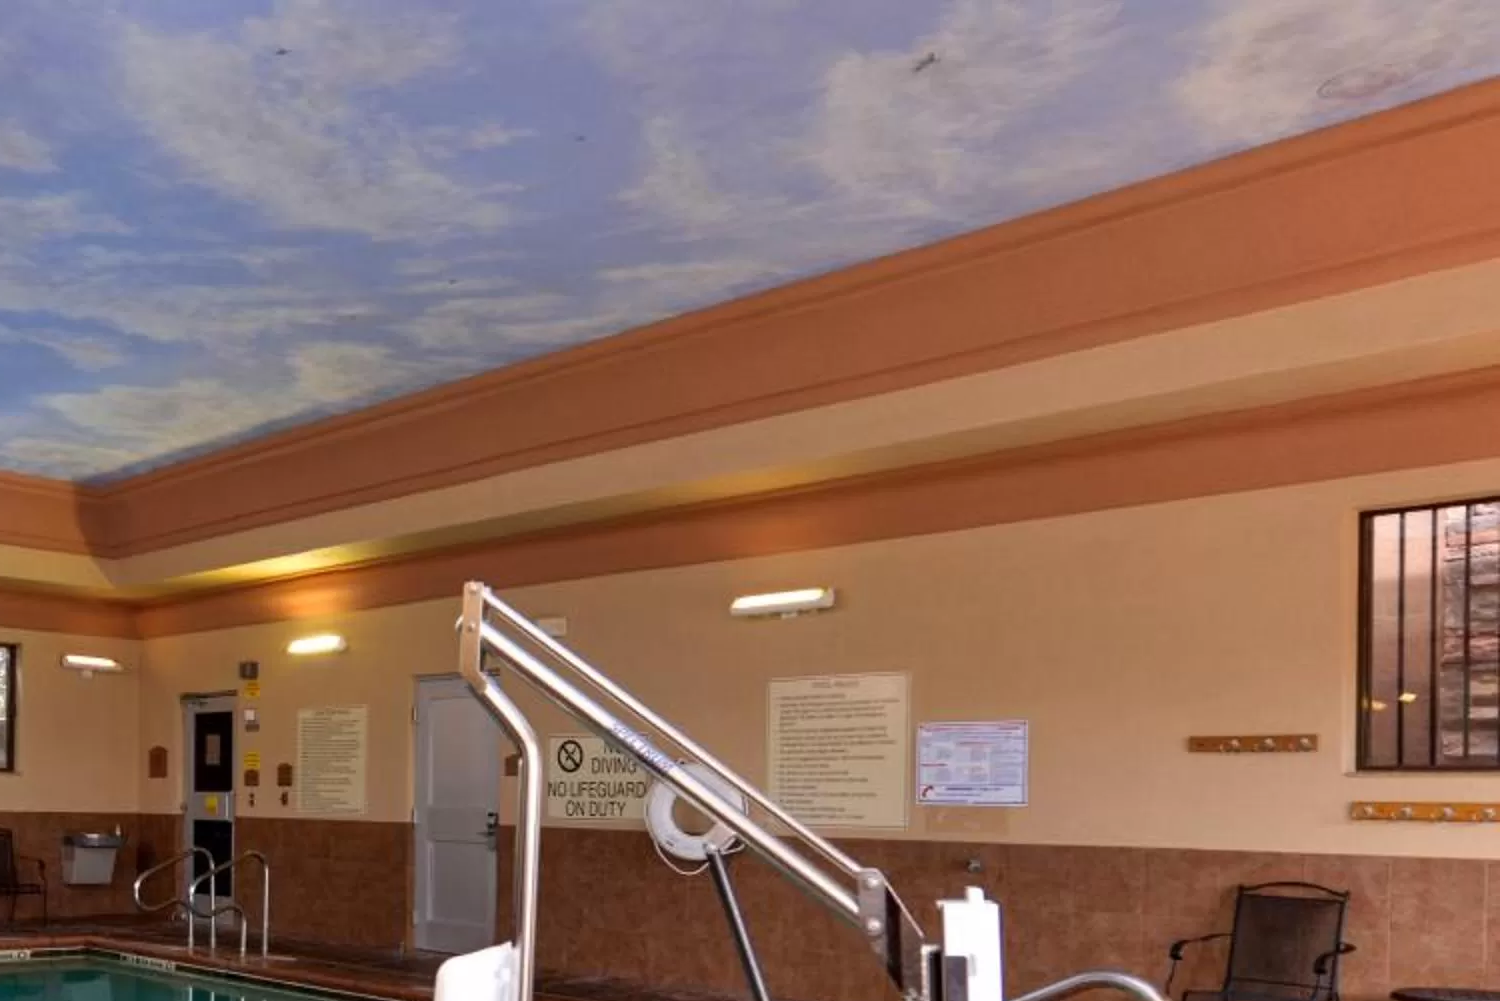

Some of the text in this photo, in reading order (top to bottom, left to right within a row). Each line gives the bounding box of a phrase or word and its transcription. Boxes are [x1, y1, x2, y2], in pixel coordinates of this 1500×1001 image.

[591, 757, 637, 775] DIVING
[548, 781, 647, 798] NO LIFEGUARD
[565, 800, 626, 816] ON DUTY
